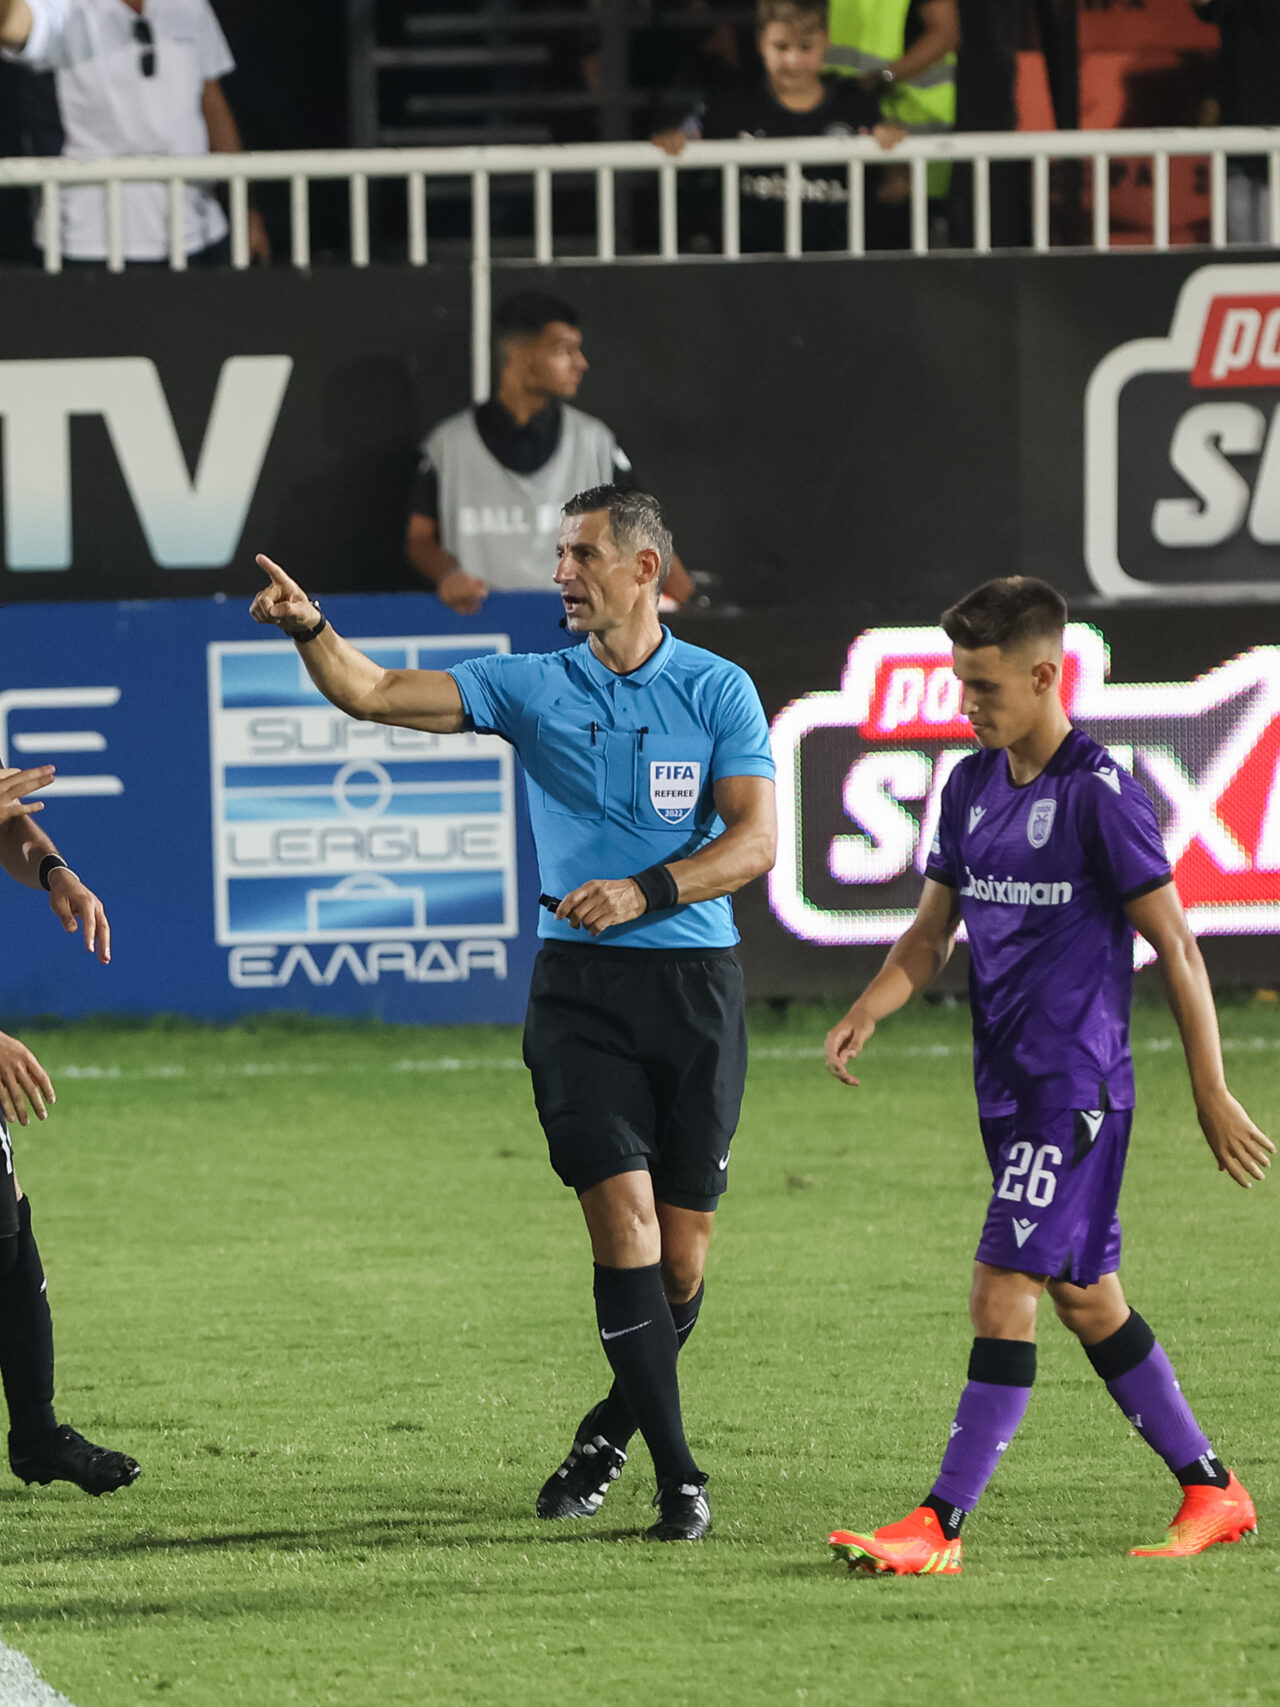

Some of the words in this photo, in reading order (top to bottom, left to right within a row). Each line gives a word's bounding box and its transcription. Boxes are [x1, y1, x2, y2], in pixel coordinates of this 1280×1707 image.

[655, 765, 695, 780] FIFA
[654, 789, 695, 798] REFEREE
[664, 809, 684, 818] 2022
[227, 822, 499, 868] LEAGUE
[997, 1140, 1064, 1208] 26
